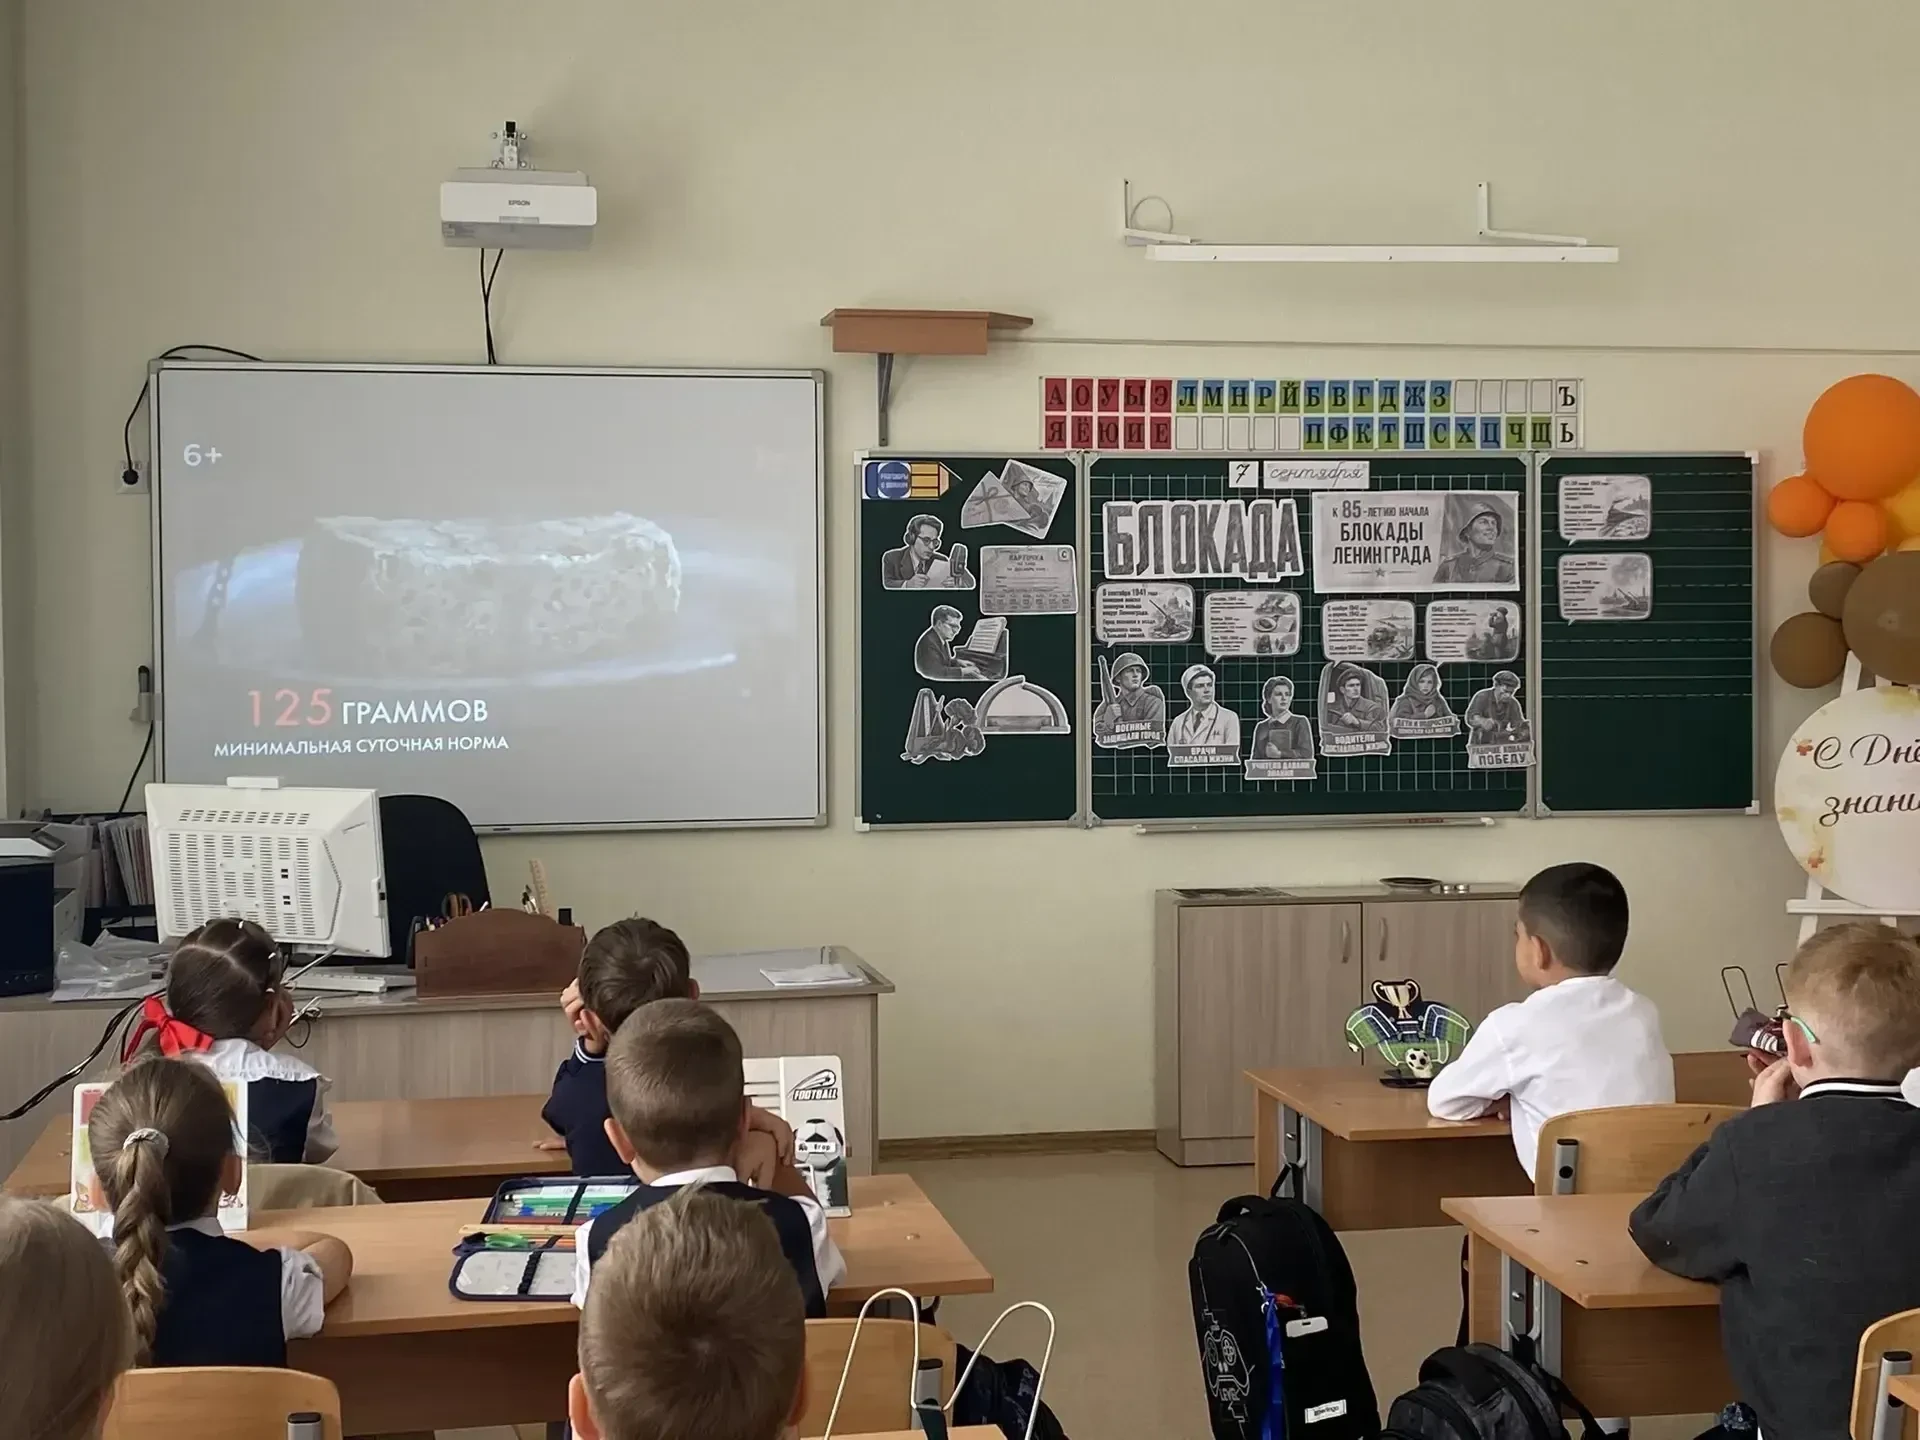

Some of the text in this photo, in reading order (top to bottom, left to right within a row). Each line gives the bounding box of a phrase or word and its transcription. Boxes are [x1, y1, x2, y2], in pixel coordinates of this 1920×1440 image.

[1050, 381, 1575, 412] А О У Ы Э Л М Н Р Й Б В Г Д Ж З Ъ
[1049, 416, 1574, 448] Я Ё Ю И Е П Ф К Т Ш С Х Ц Ч Щ Ь
[183, 443, 223, 466] 6+
[1236, 461, 1364, 487] 7 сентября
[1399, 507, 1429, 517] НАЧАЛА
[1106, 503, 1300, 578] БЛОКАДА
[1340, 522, 1423, 543] БЛОКАДЫ
[1332, 546, 1432, 566] ЛЕНИНГРАДА
[248, 688, 489, 728] 125 ГРАММОВ
[1115, 722, 1152, 733] ВОЕННЫЕ
[213, 735, 510, 757] МИНИМАЛЬНАЯ СУТОЧНАЯ НОРМА
[1335, 734, 1376, 744] ВОДИТЕЛИ
[1174, 755, 1208, 763] СПАСАЛИ
[1190, 747, 1216, 755] ВРАЧИ
[1478, 753, 1526, 765] ПОБЕДУ
[1813, 736, 1843, 769] С
[793, 1087, 838, 1100] FOOTBALL
